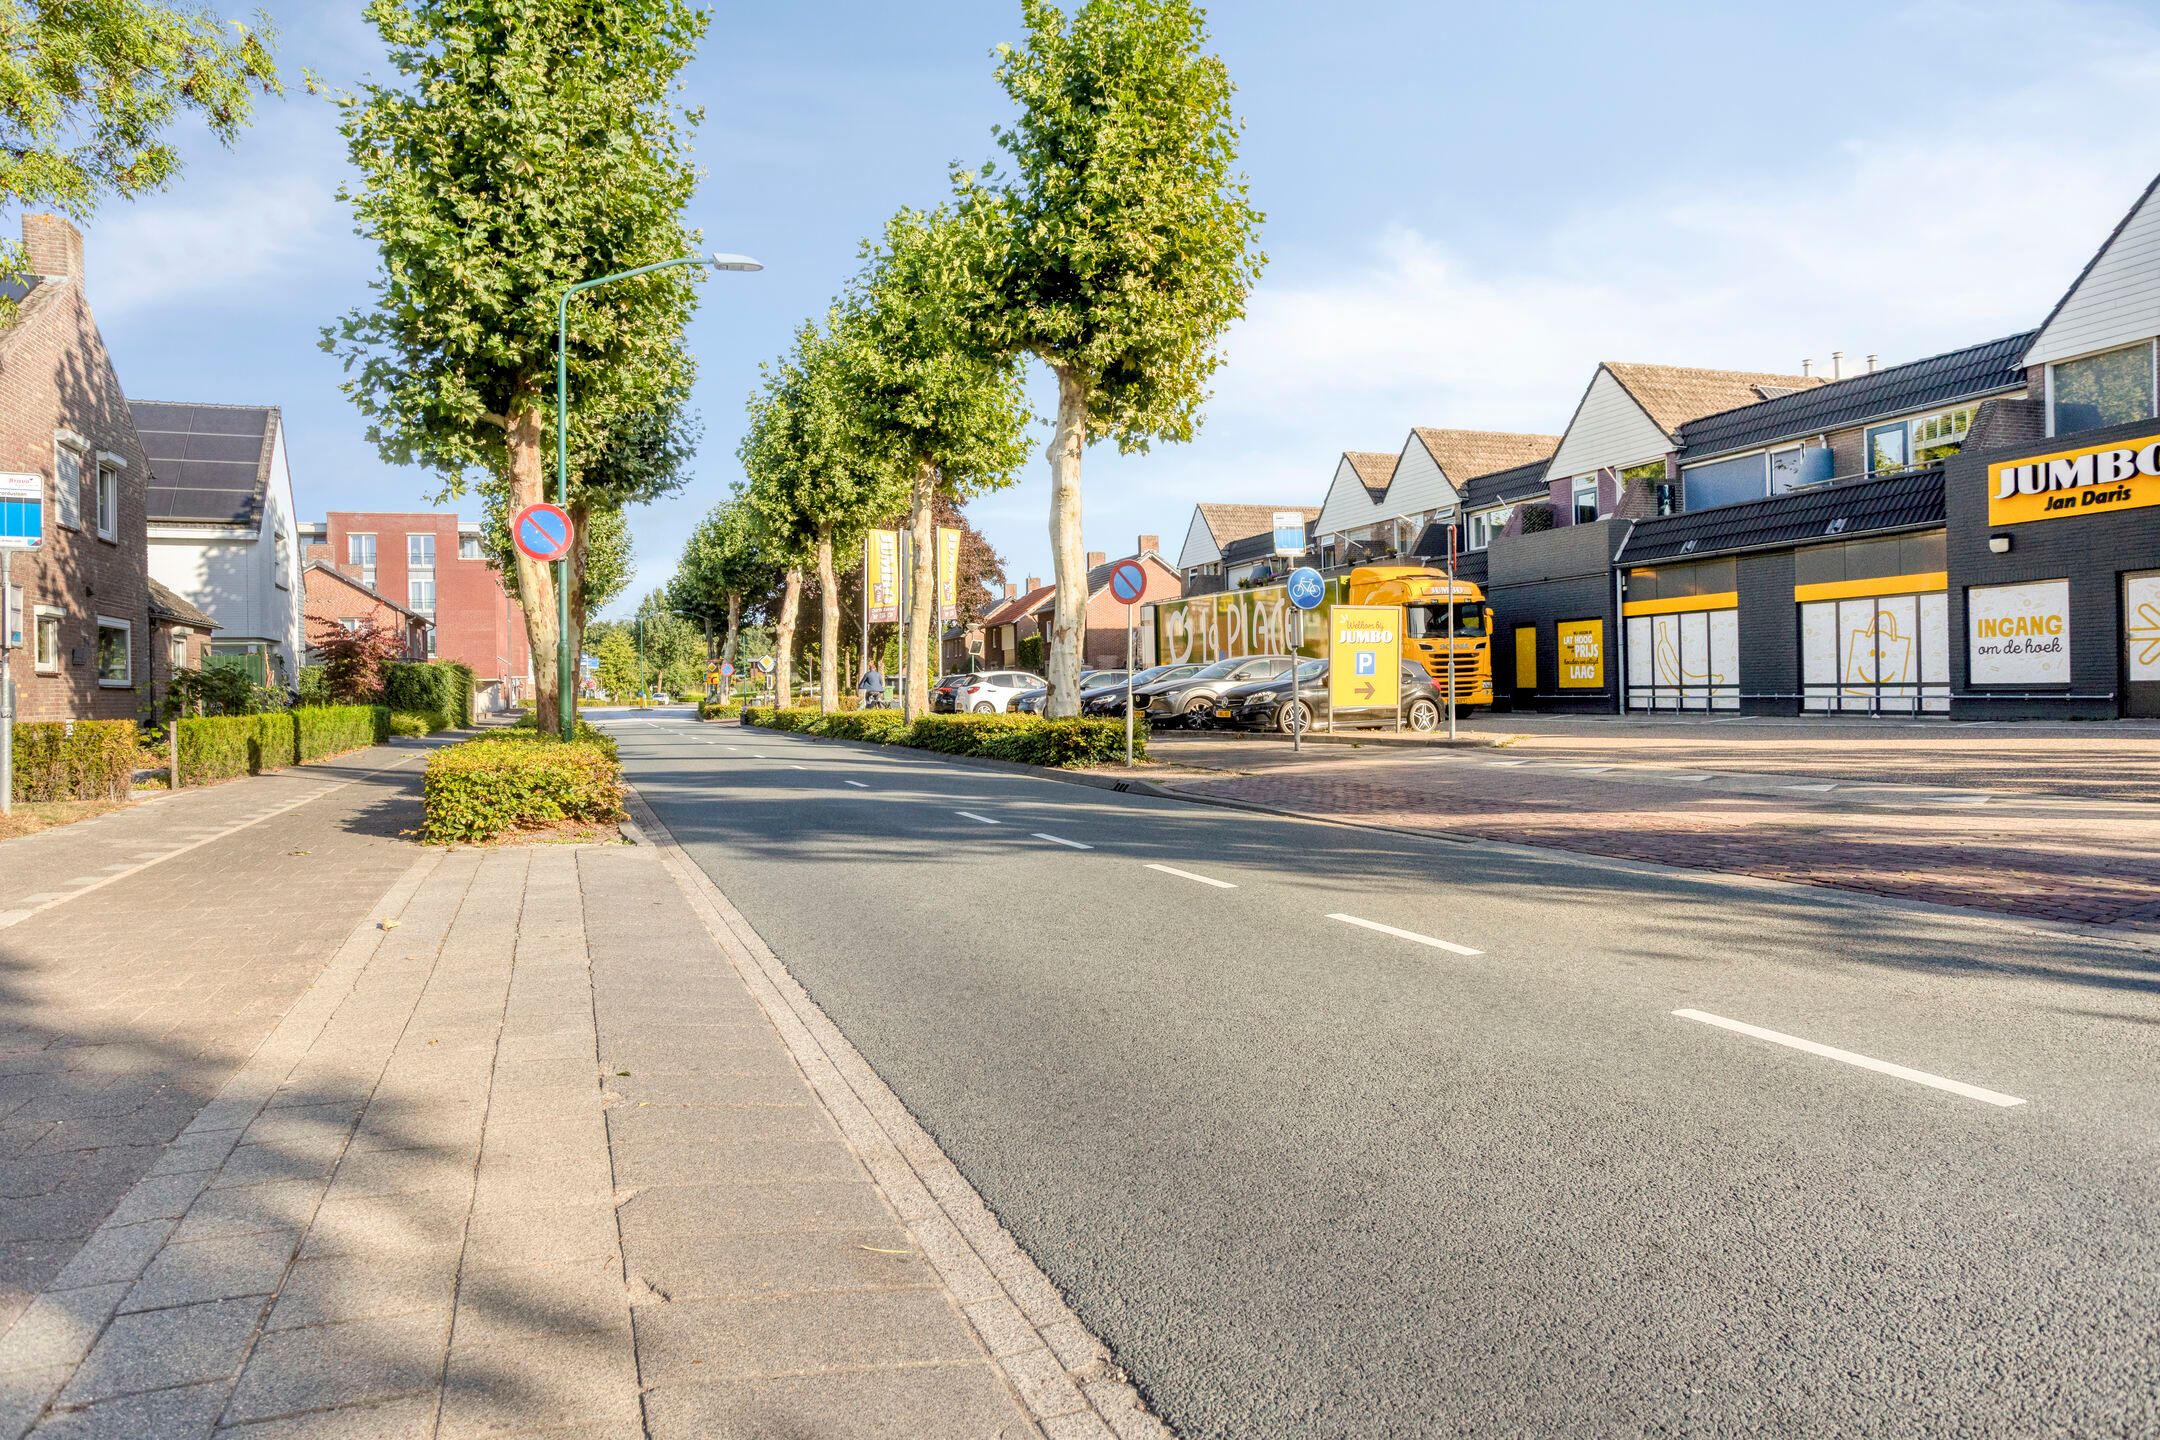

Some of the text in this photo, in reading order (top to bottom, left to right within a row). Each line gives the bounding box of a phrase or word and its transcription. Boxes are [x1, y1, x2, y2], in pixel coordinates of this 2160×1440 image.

[2044, 485, 2132, 511] Jan Daris
[1977, 614, 2062, 638] INGANG
[1339, 630, 1393, 643] JUMBO
[1575, 644, 1599, 658] PRIJS
[1978, 637, 2062, 655] om de hoek
[1359, 654, 1372, 673] P
[1570, 666, 1595, 679] LAAG
